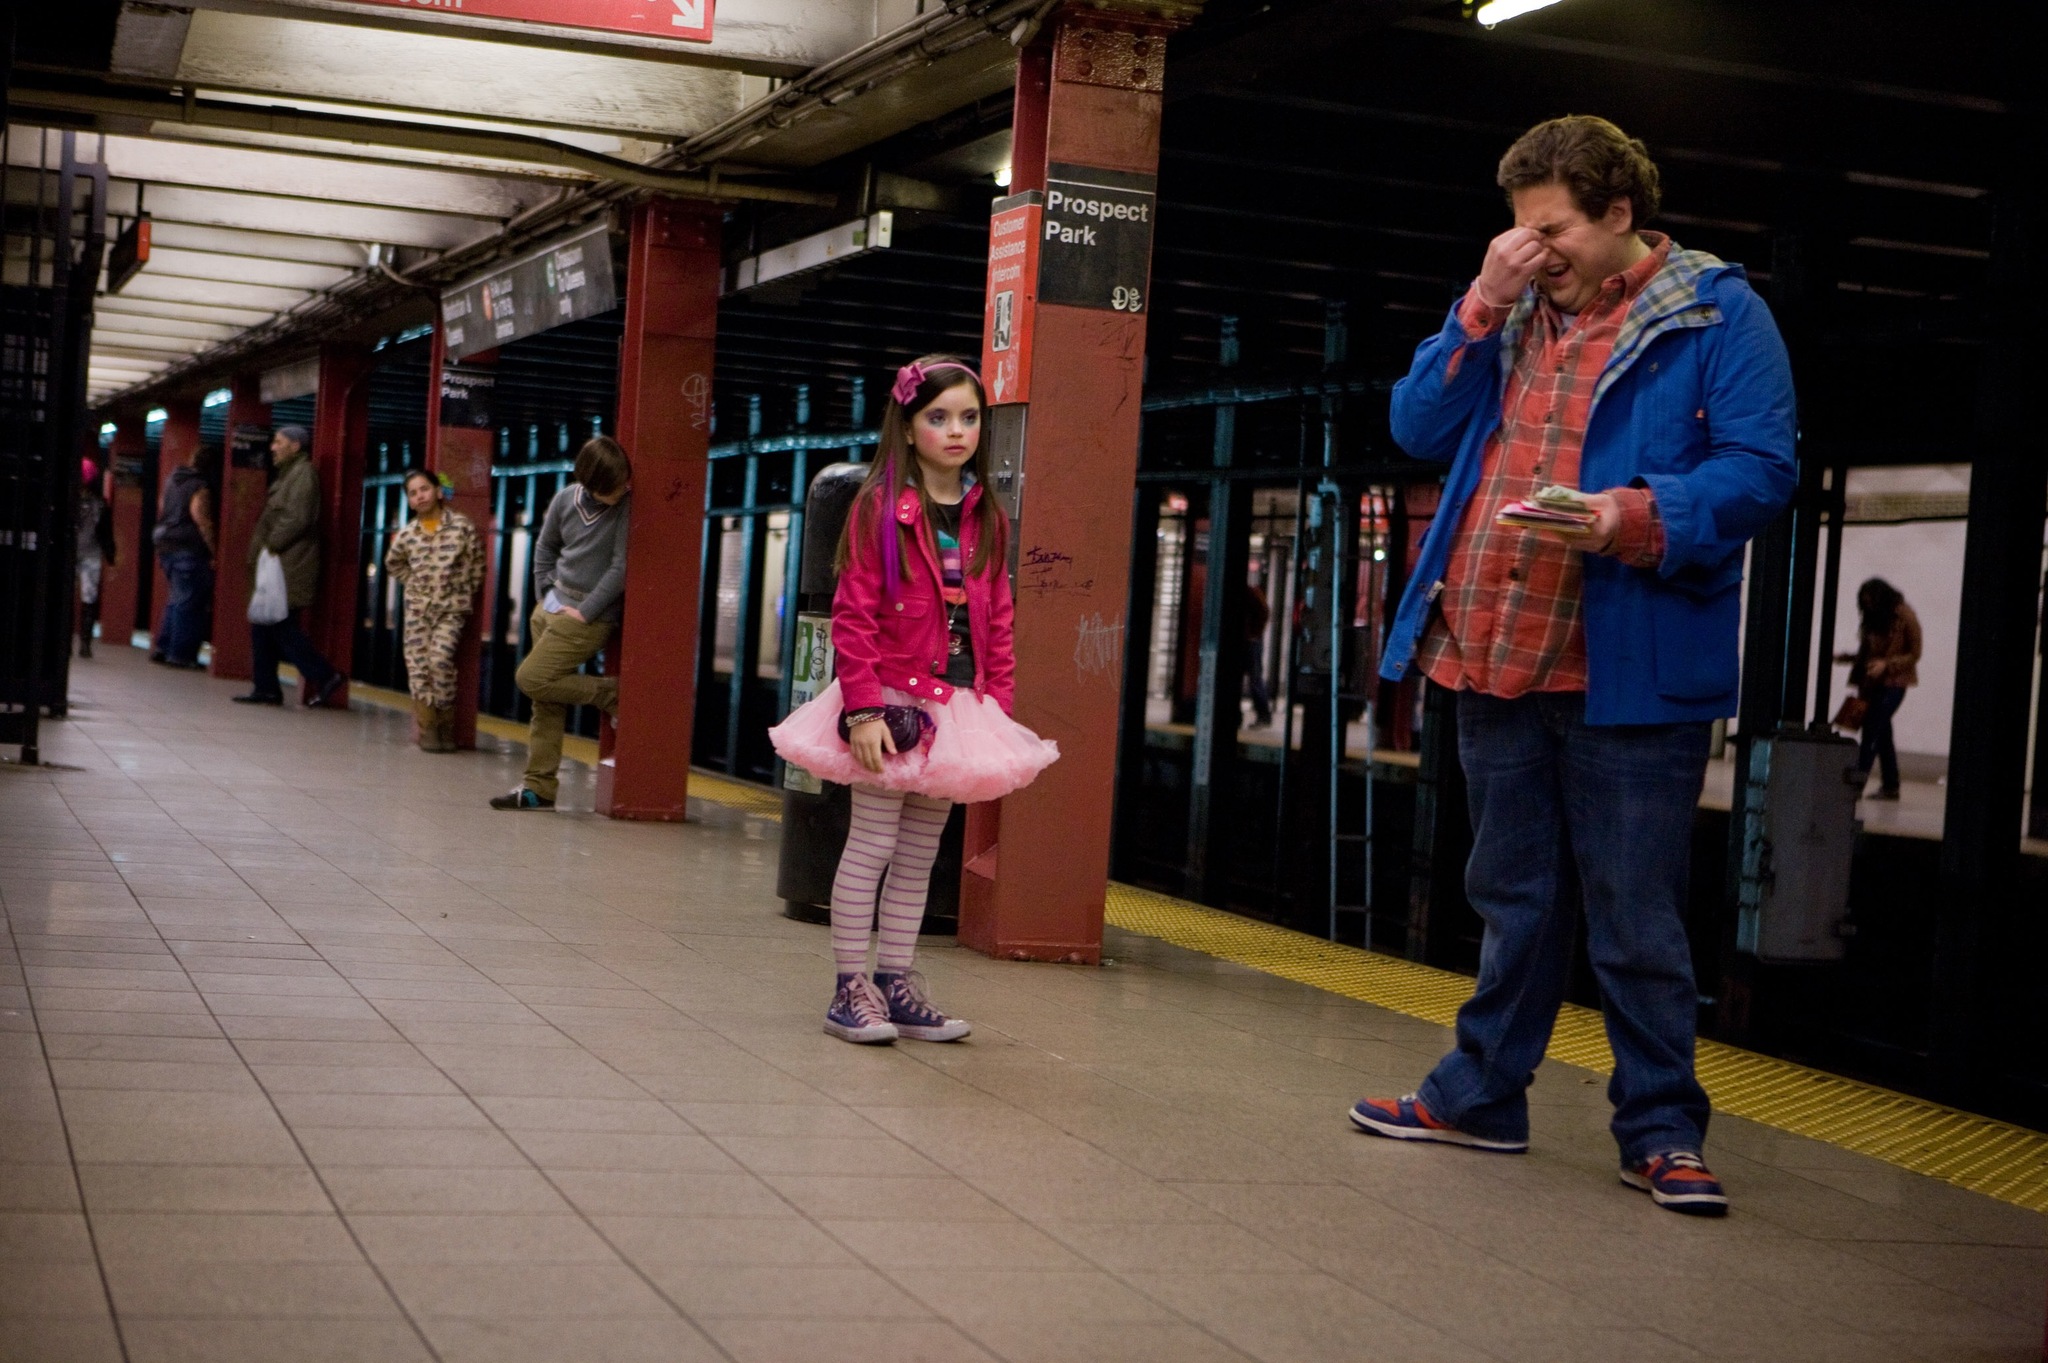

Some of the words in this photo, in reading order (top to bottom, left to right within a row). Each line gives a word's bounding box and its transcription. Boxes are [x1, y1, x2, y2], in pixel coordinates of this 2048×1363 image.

[1047, 190, 1149, 222] Prospect
[994, 217, 1026, 237] Customer
[1045, 221, 1097, 246] Park
[991, 240, 1026, 260] Assistance
[993, 264, 1020, 282] Intercom
[443, 373, 495, 388] Prospect
[442, 387, 469, 400] Park
